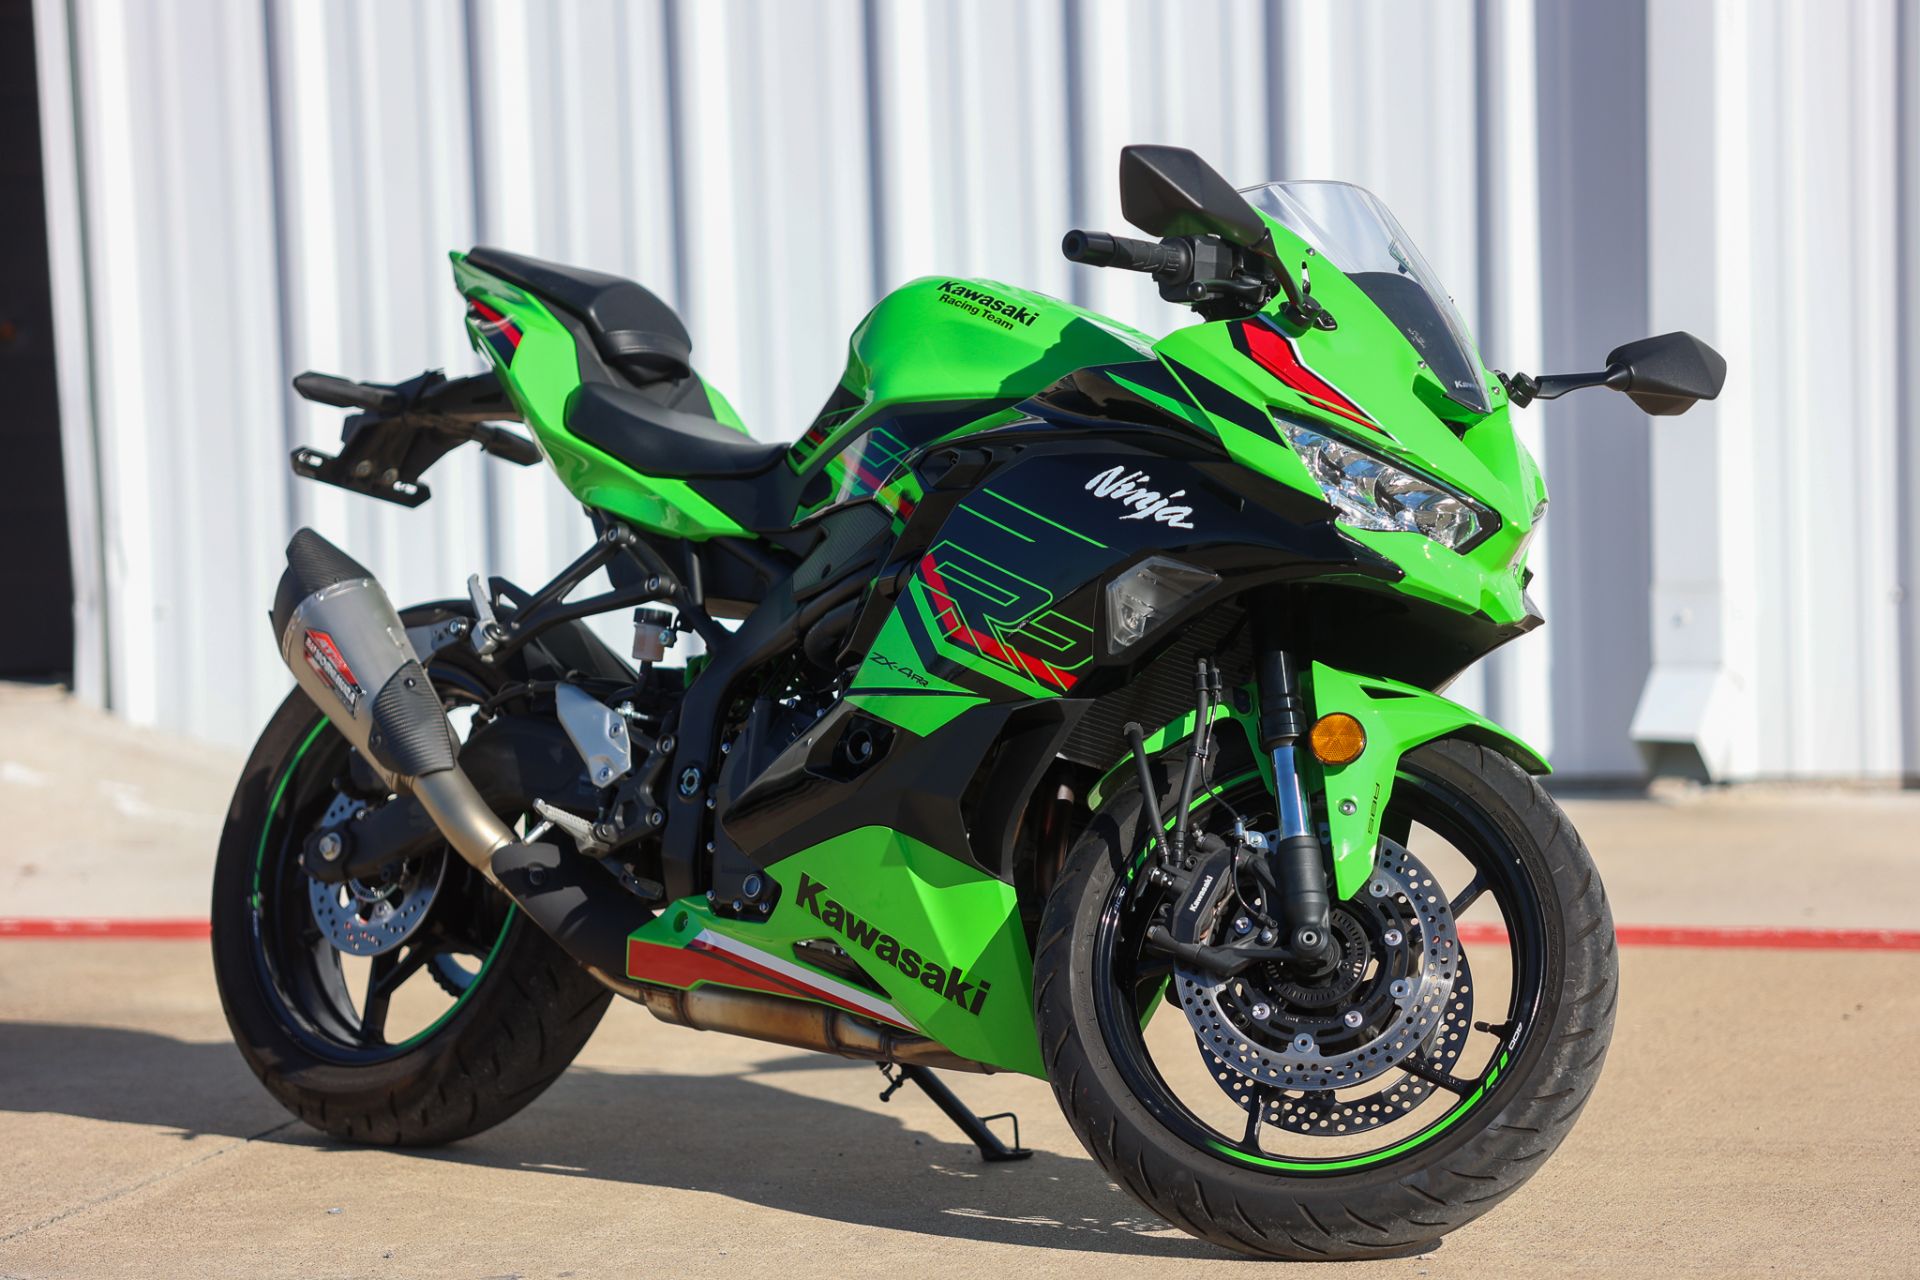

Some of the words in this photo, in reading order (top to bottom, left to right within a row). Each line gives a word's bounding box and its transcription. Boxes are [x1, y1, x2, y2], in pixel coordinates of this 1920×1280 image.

[937, 281, 1040, 327] Kawasaki
[939, 294, 980, 316] Racing
[982, 310, 1014, 331] Team
[1085, 465, 1194, 529] Ninja
[1367, 782, 1380, 835] ABS
[1189, 875, 1213, 912] Kawasaki
[795, 872, 991, 1016] Kawasaki
[1508, 1022, 1523, 1051] 400
